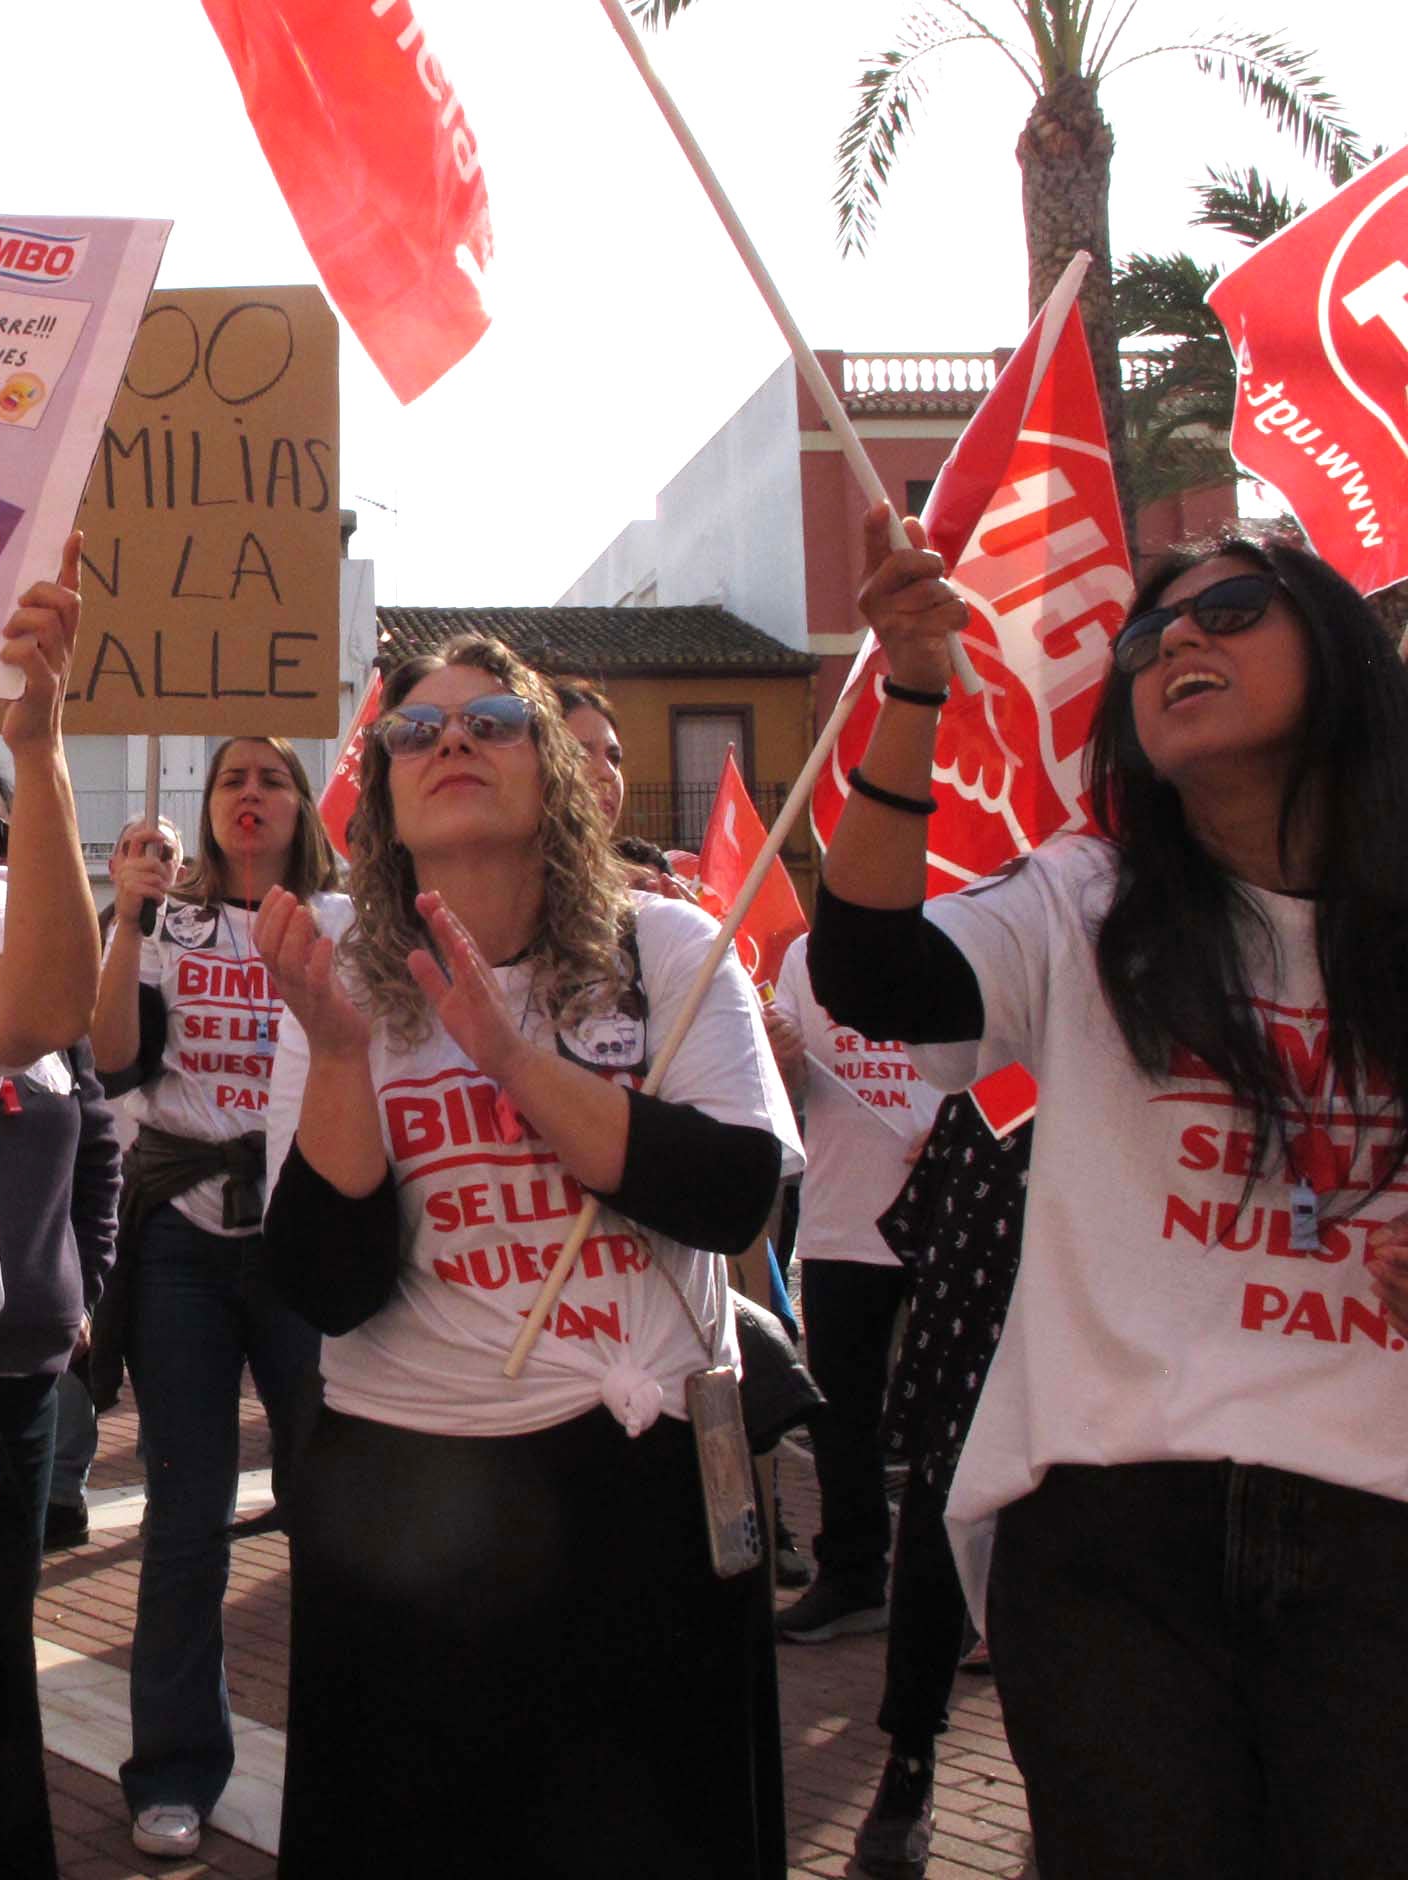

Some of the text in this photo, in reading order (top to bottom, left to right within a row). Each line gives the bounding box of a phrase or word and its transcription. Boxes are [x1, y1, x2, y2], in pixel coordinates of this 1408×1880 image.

[83, 414, 330, 512] MILIAS
[172, 534, 284, 604] LA
[64, 632, 319, 702] ALLE
[184, 1015, 222, 1039] SE
[835, 1035, 858, 1053] SE
[1177, 1124, 1264, 1180] SE
[425, 1184, 495, 1232] SE
[1240, 1284, 1405, 1352] PAN.
